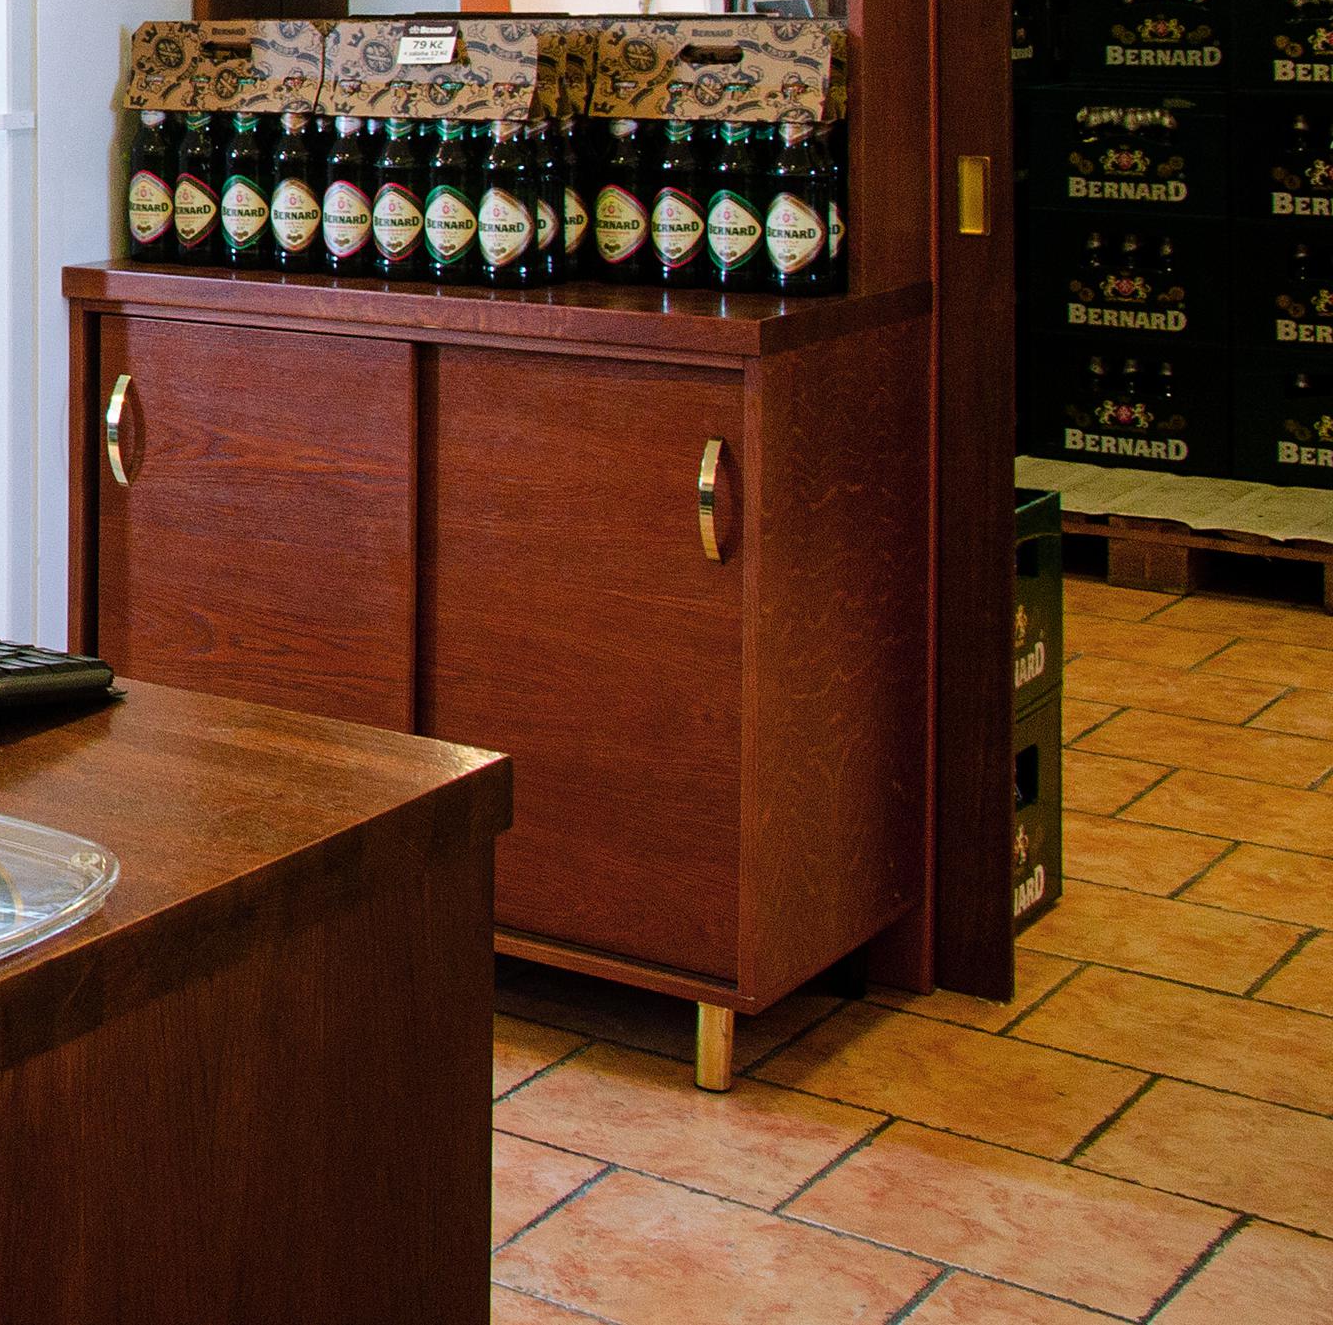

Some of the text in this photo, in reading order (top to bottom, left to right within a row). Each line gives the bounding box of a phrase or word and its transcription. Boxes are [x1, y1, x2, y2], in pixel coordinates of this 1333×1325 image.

[412, 39, 444, 49] 79 Kč
[1106, 45, 1222, 67] BERNARD
[1068, 176, 1187, 202] BERNARD
[221, 205, 266, 219] BERNARD
[272, 208, 320, 221] BERNARD
[322, 213, 369, 226] BERNARD
[373, 215, 421, 229] BERNARD
[425, 218, 475, 231] BERNARD
[708, 224, 758, 237] BERNARD
[1067, 303, 1187, 332] BERNARD
[1064, 427, 1188, 462] BERNARD
